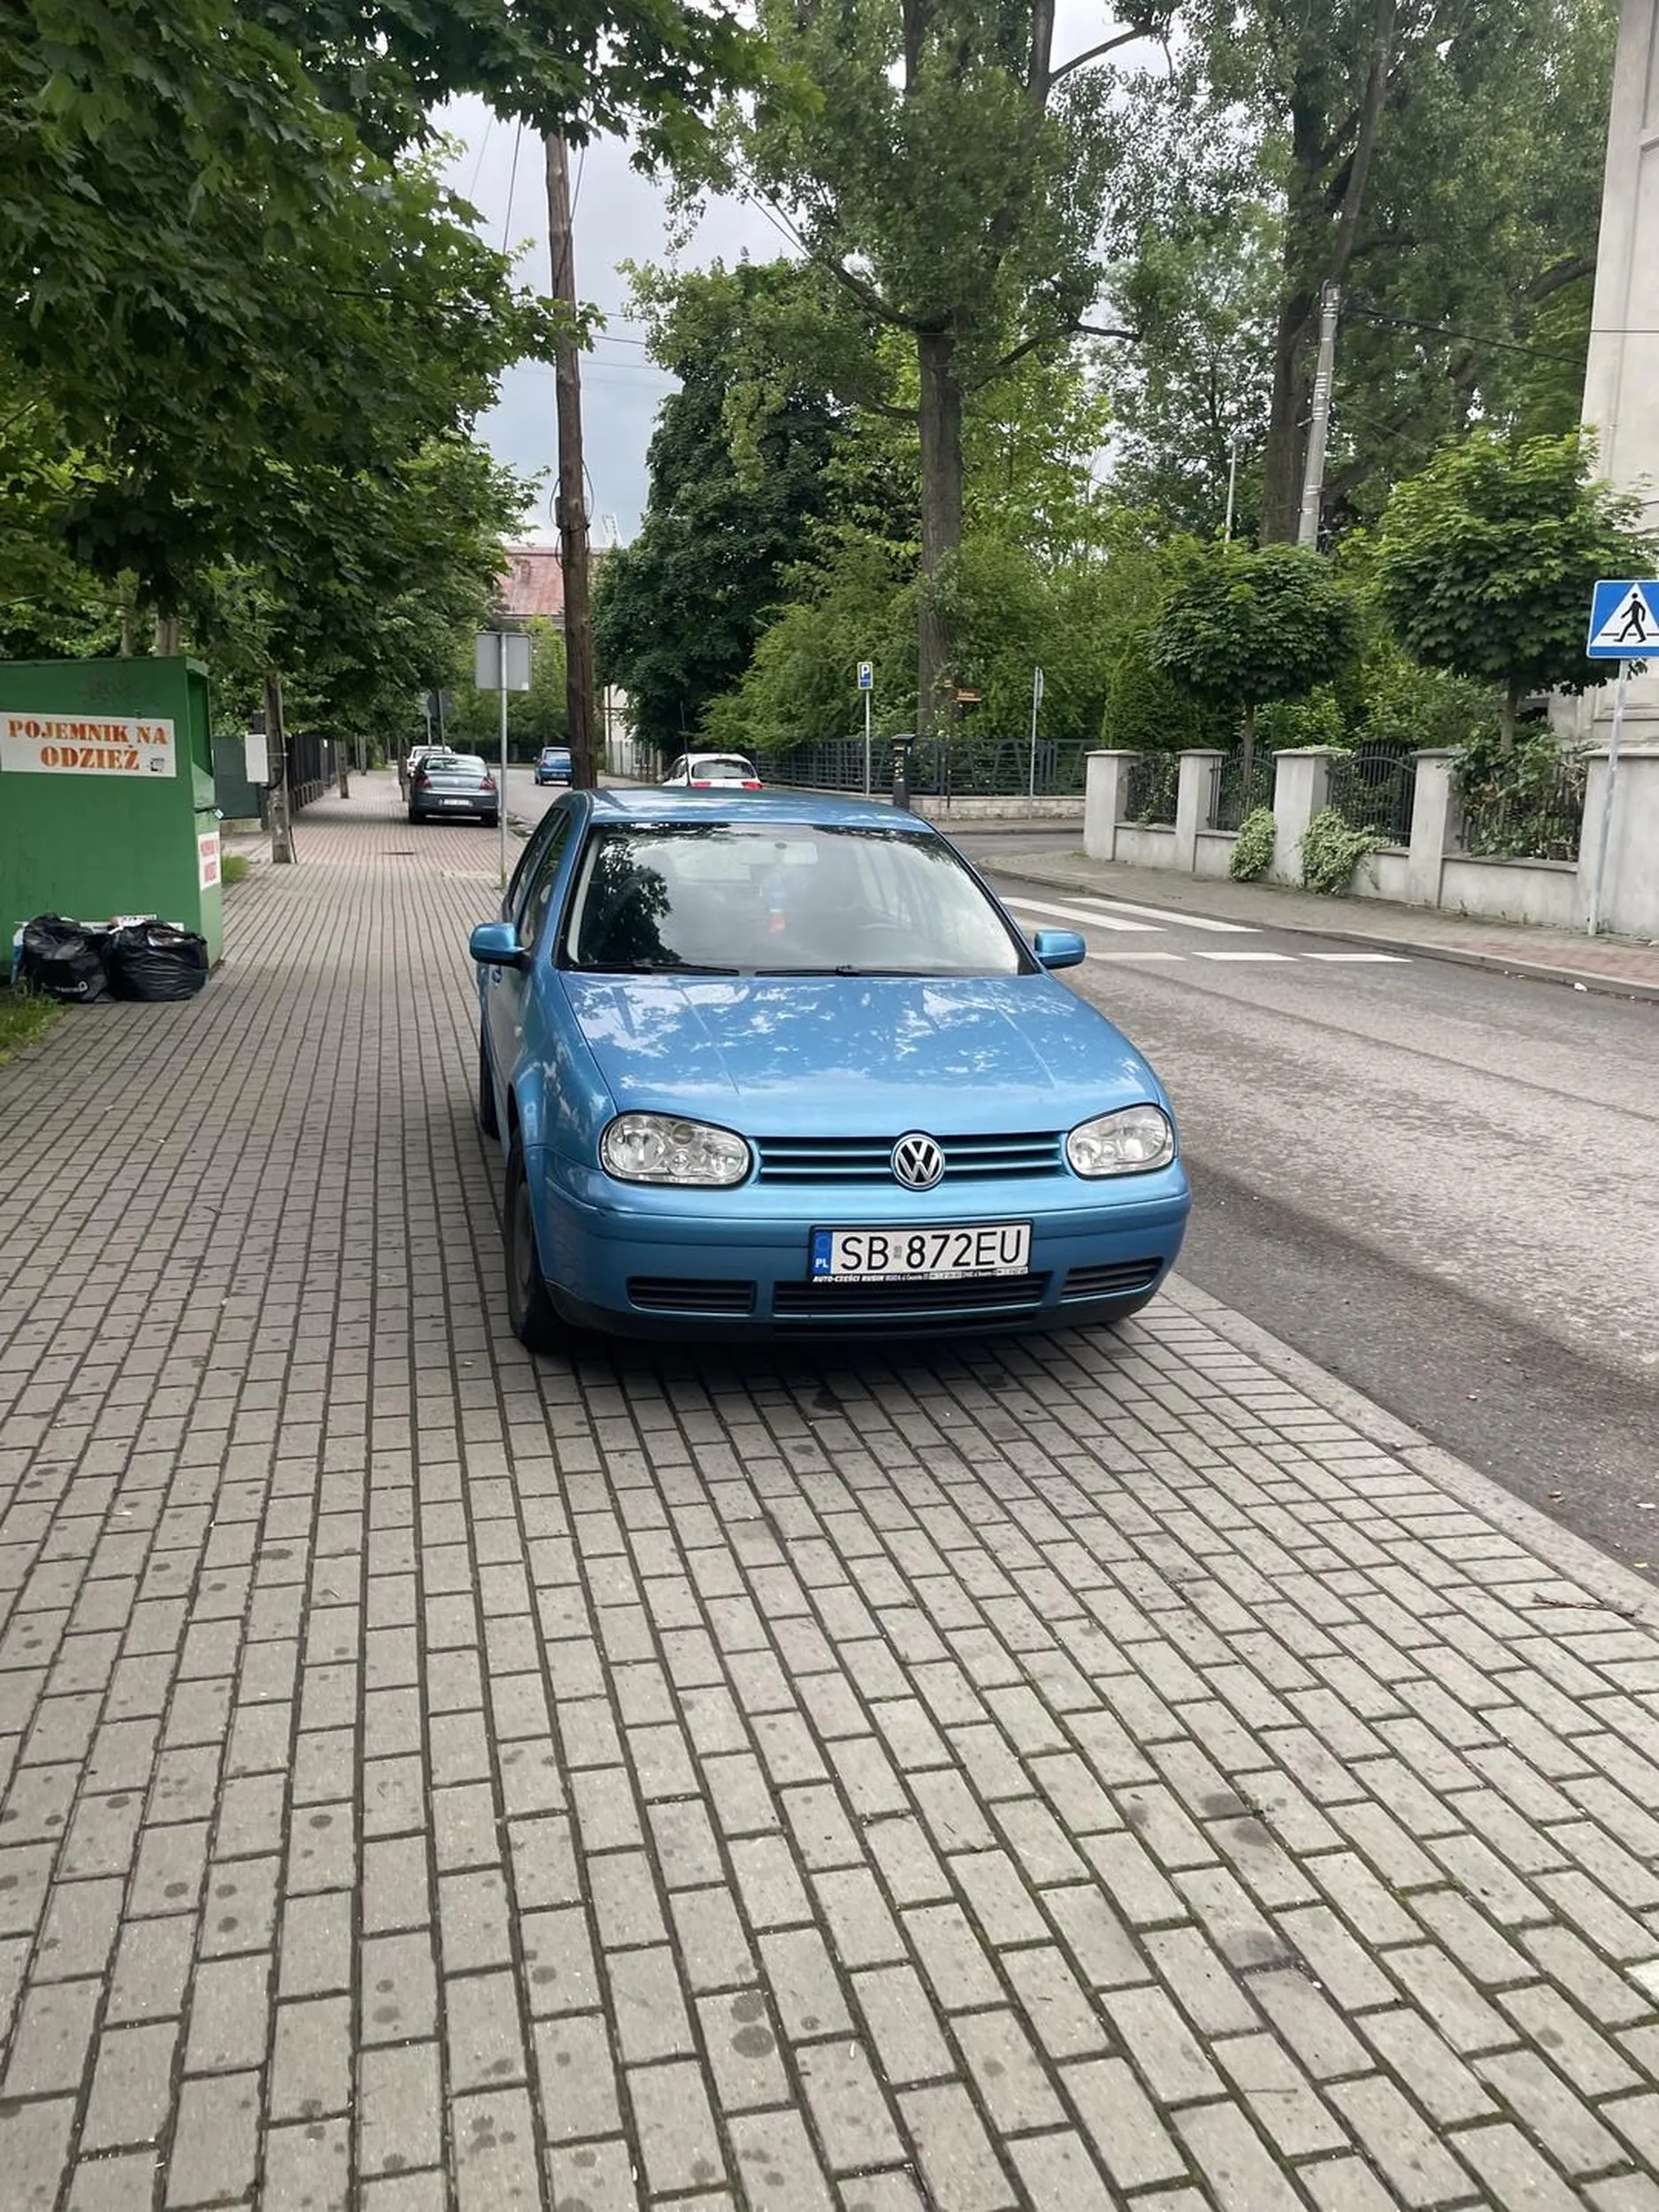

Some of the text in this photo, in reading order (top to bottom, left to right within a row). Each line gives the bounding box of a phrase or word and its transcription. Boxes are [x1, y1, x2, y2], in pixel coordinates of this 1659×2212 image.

[861, 664, 870, 678] P
[9, 719, 167, 744] POJEMNIK NA
[41, 744, 140, 770] ODZIEŻ
[892, 1134, 944, 1189] VW
[815, 1257, 828, 1268] PL
[841, 1229, 1021, 1271] SB 872EU
